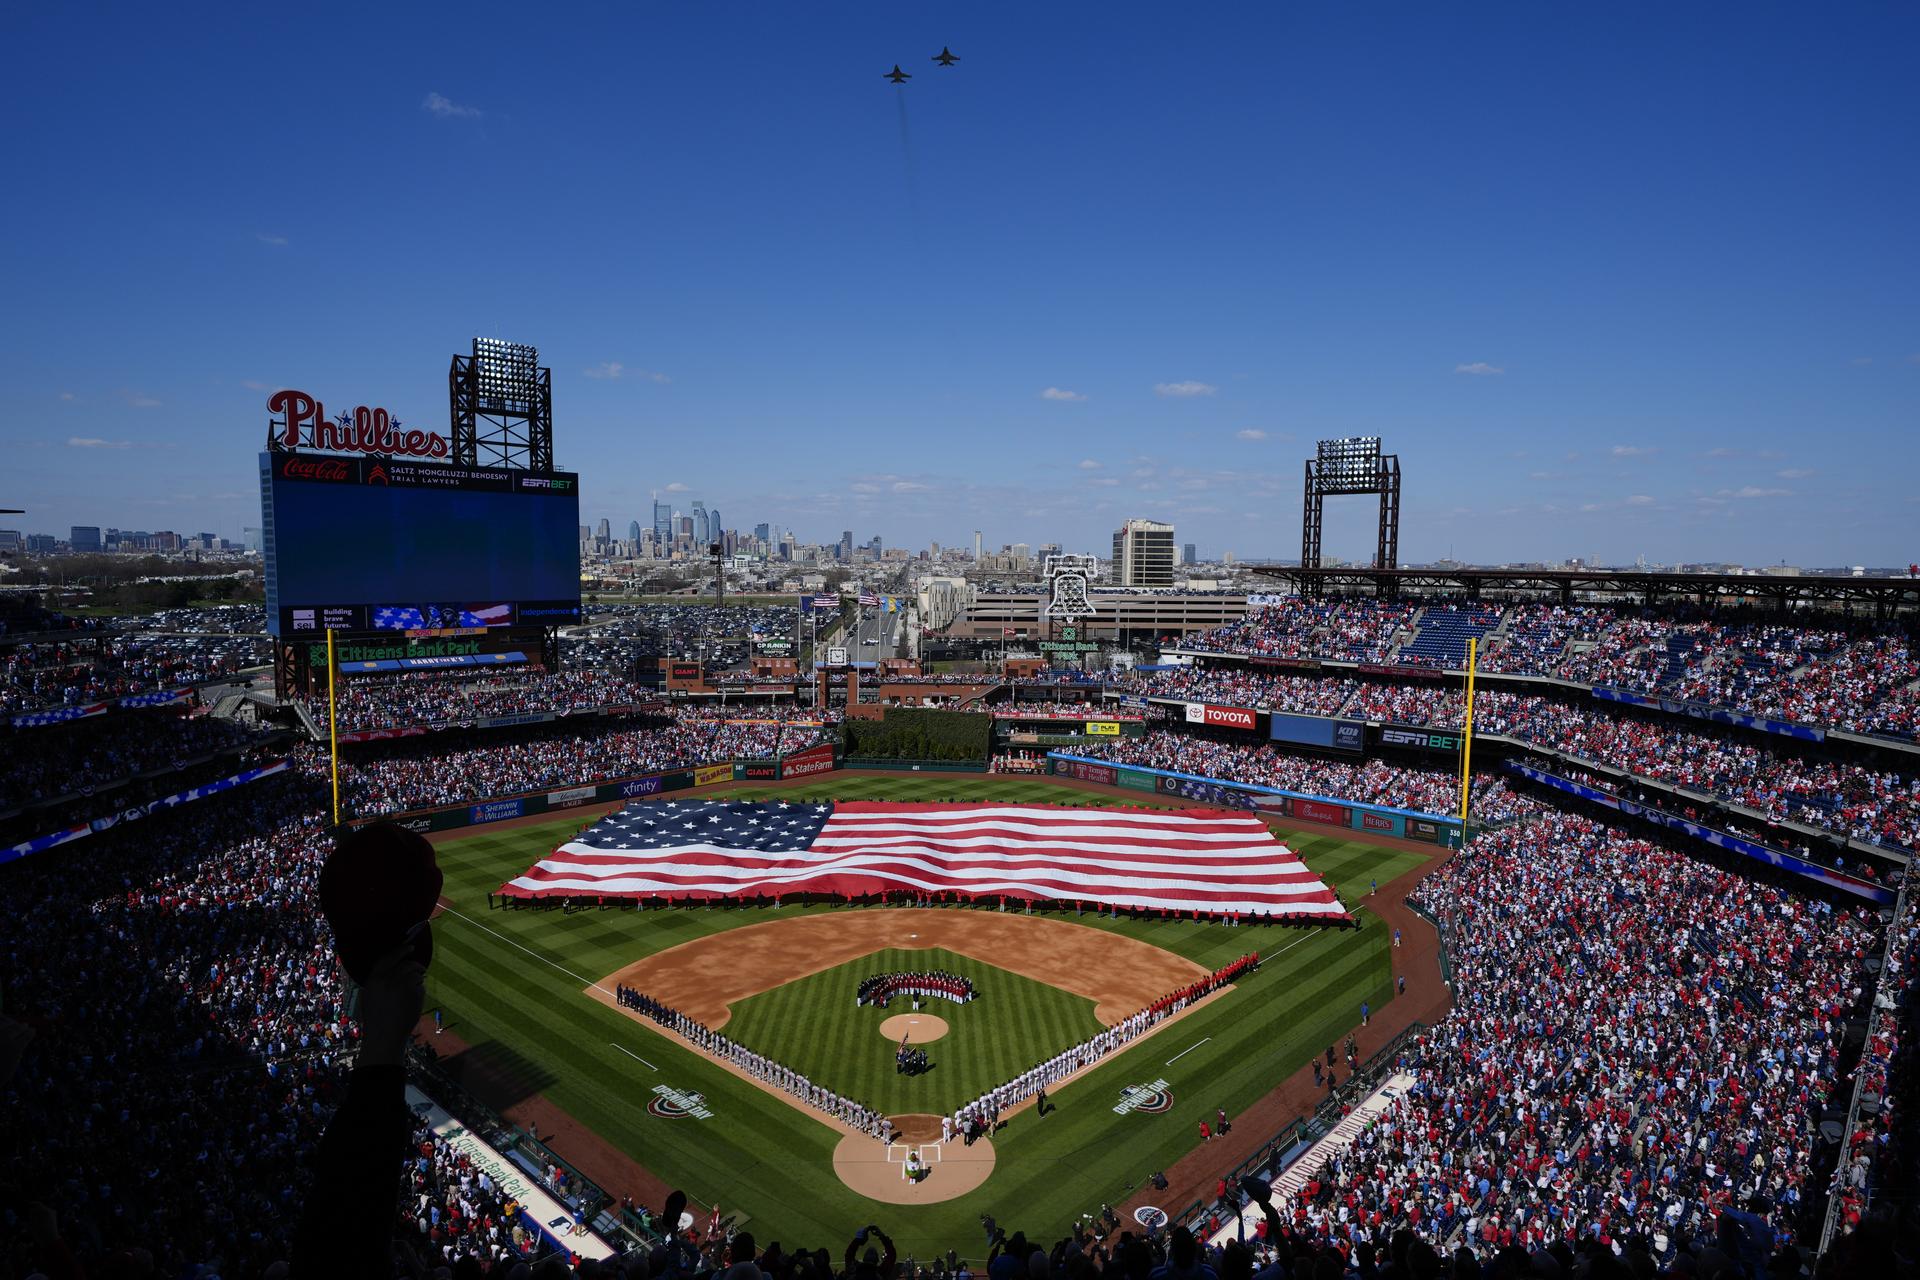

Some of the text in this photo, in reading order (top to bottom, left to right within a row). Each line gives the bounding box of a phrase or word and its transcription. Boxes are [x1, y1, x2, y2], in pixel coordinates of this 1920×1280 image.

[267, 389, 448, 458] Phillies
[390, 466, 509, 480] SALTZ MONGELUZZI BENDESKY
[391, 475, 416, 483] TRIAL
[522, 478, 572, 489] ESPN BET
[338, 640, 480, 662] Citizens Bank Park
[1039, 642, 1099, 651] Citizens Bank
[608, 706, 632, 714] TOYOTA
[641, 702, 664, 711] TOYOTA
[1207, 709, 1252, 724] TOYOTA
[1383, 730, 1465, 750] ESPN BET
[1088, 773, 1108, 783] Health
[1089, 766, 1110, 776] Temple
[623, 780, 657, 796] xfinity
[485, 803, 518, 814] SHERWIN
[652, 1085, 715, 1120] OPENING DAY
[1113, 1078, 1170, 1115] OPENING DAY
[1271, 1106, 1379, 1198] PHILADELPHIA PHILLIES
[457, 1138, 532, 1198] Citizens Bank Park
